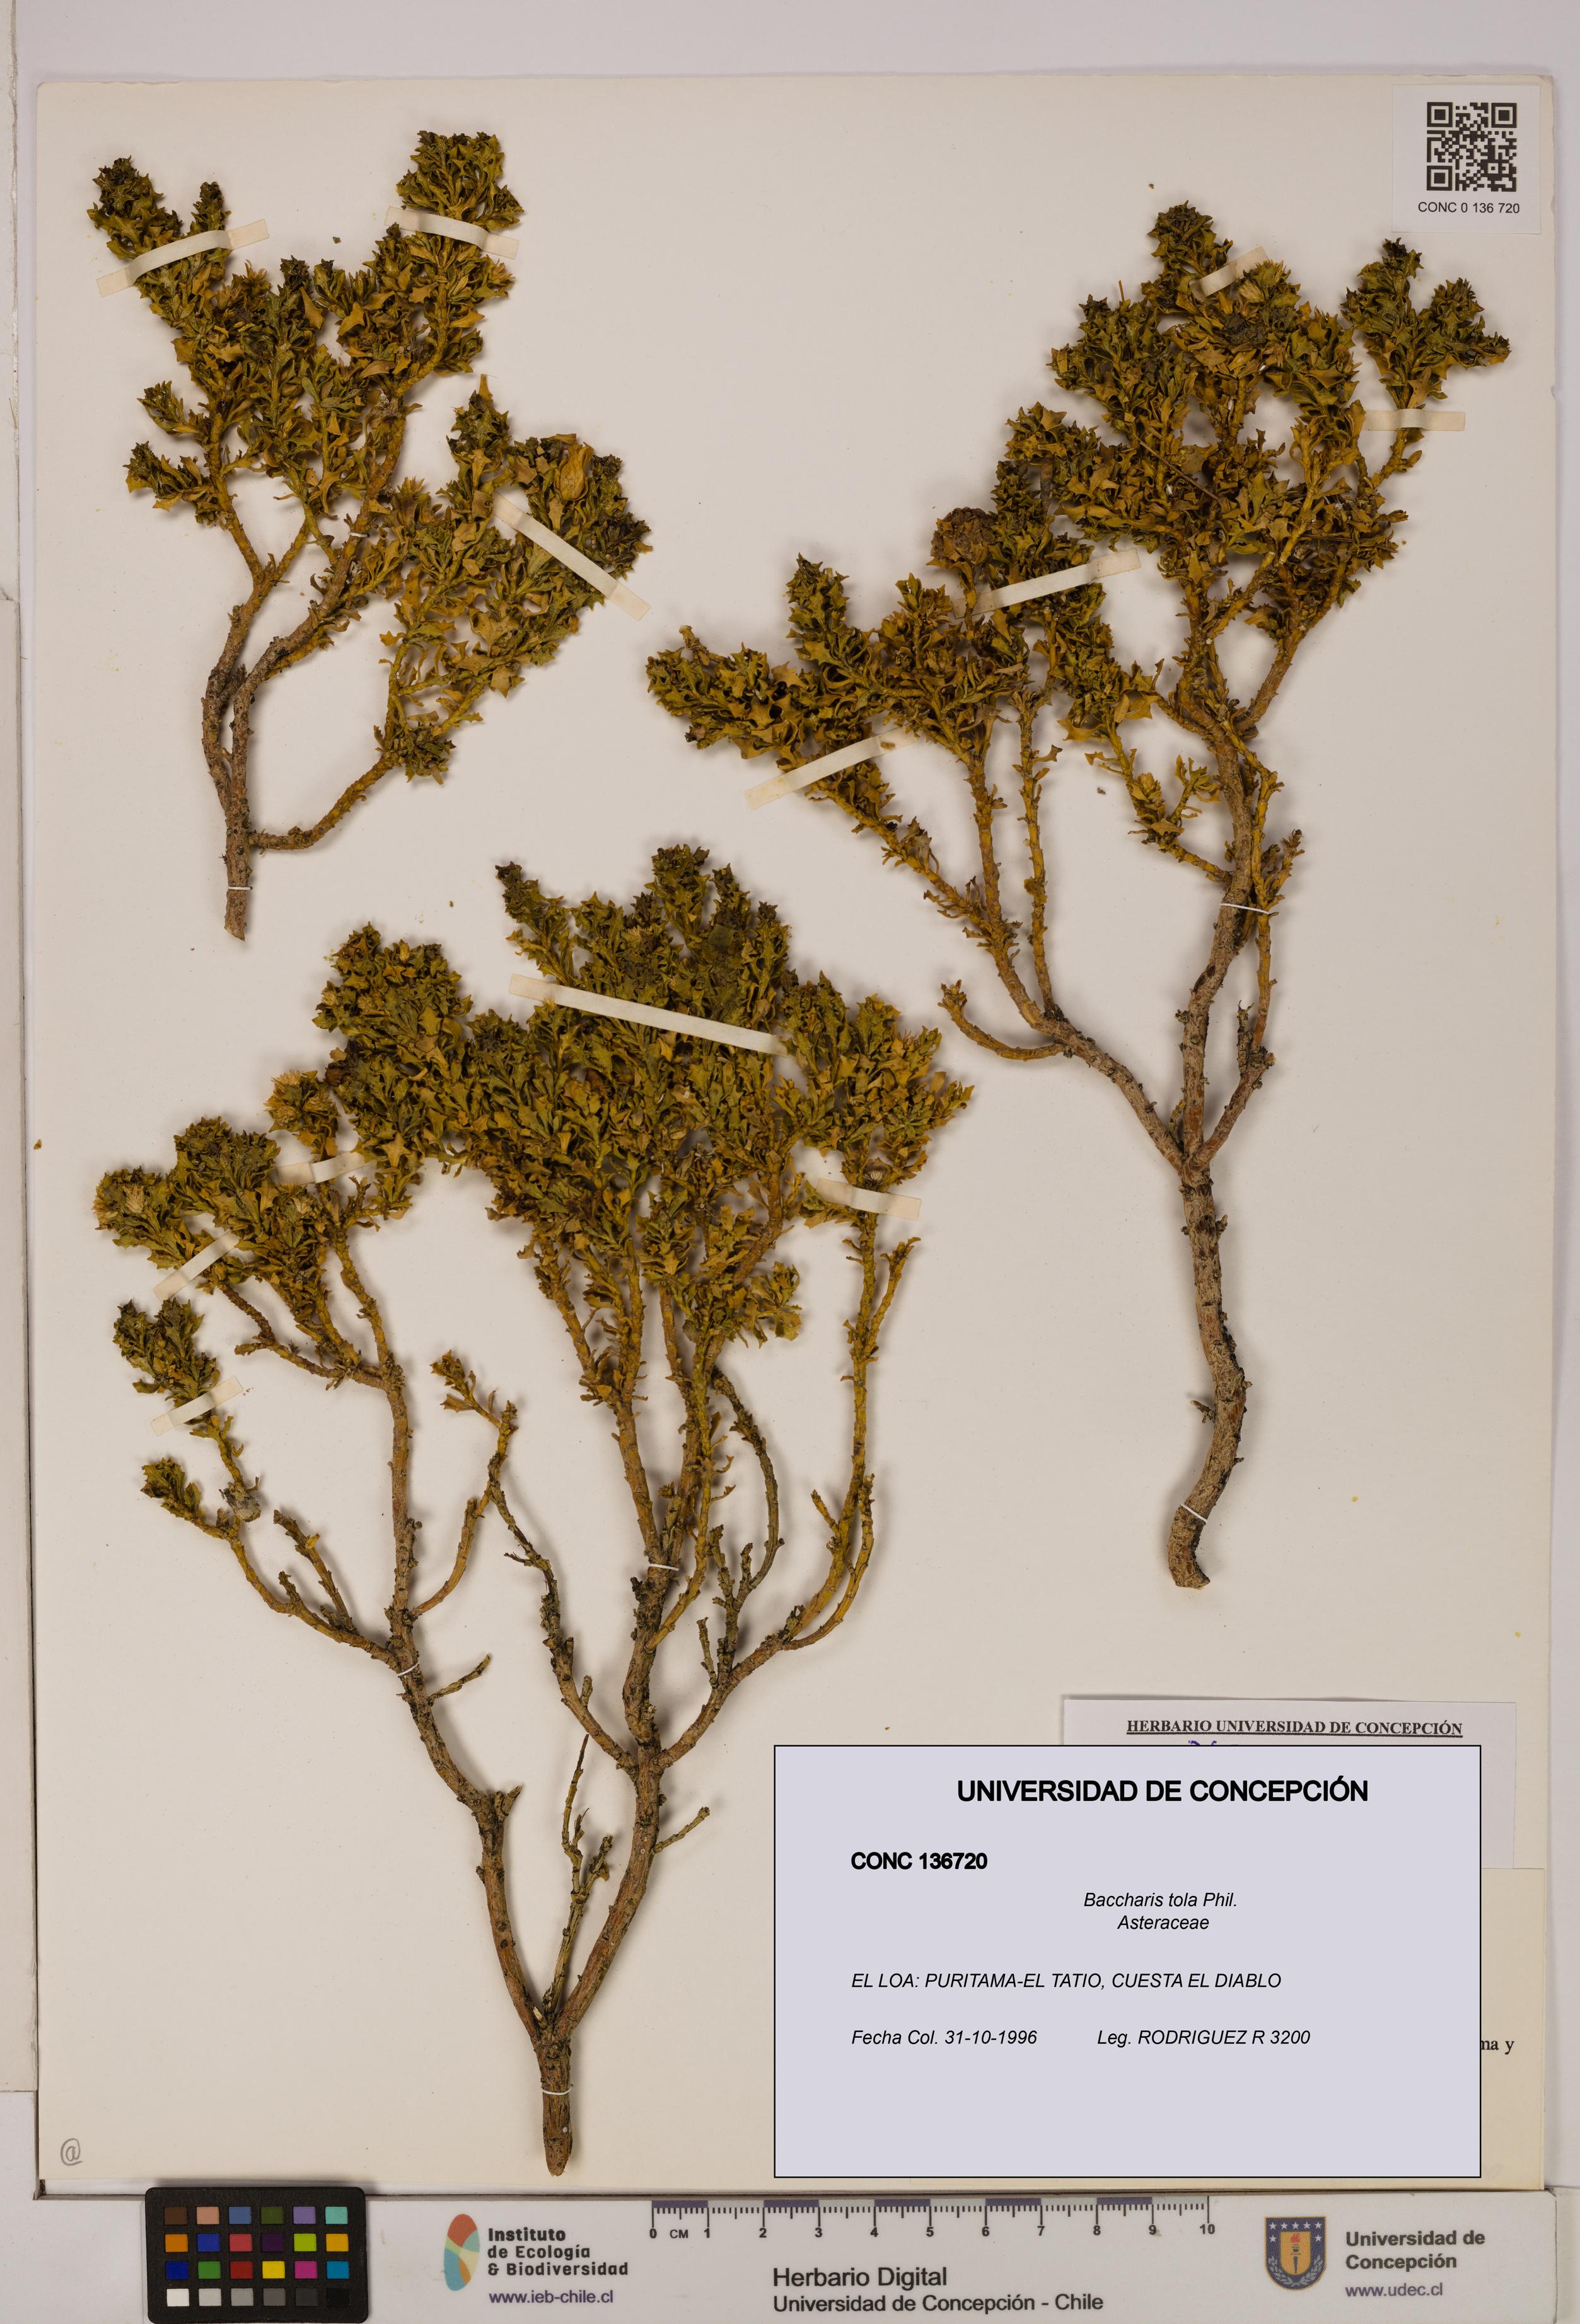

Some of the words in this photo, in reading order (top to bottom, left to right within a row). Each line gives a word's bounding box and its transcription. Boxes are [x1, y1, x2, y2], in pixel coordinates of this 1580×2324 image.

[1417, 201, 1457, 213] CONC
[1460, 202, 1468, 213] 0
[1472, 202, 1494, 214] 136
[1497, 202, 1520, 214] 720
[1127, 1720, 1212, 1733] HERBARIO
[1216, 1720, 1326, 1733] UNIVERSIDAD
[1329, 1721, 1352, 1734] DE
[1355, 1720, 1463, 1735] CONCEPCIÓN
[1504, 2040, 1515, 2055] y
[487, 2227, 566, 2242] Instituto
[649, 2228, 658, 2238] 0
[669, 2229, 689, 2239] CM
[704, 2228, 711, 2238] 1
[758, 2227, 767, 2238] 2
[814, 2227, 823, 2238] 3
[869, 2226, 879, 2238] 4
[926, 2226, 934, 2237] 5
[981, 2226, 990, 2237] 6
[1037, 2225, 1045, 2236] 7
[1093, 2225, 1101, 2236] 8
[1148, 2224, 1158, 2235] 9
[1199, 2224, 1216, 2234] 10
[1346, 2229, 1457, 2246] Universidad
[1462, 2229, 1485, 2245] de
[487, 2245, 508, 2259] de
[515, 2244, 590, 2261] Ecología
[487, 2262, 499, 2276] &
[506, 2261, 628, 2276] Biodiversidad
[1345, 2253, 1457, 2273] Concepción
[773, 2267, 870, 2287] Herbario
[878, 2266, 947, 2291] Digital
[489, 2289, 613, 2304] www.ieb-chile.cl
[1345, 2282, 1443, 2297] www.udec.cl
[774, 2294, 886, 2313] Universidad
[892, 2294, 916, 2312] de
[922, 2294, 1035, 2315] Concepción
[1055, 2293, 1104, 2311] Chile
